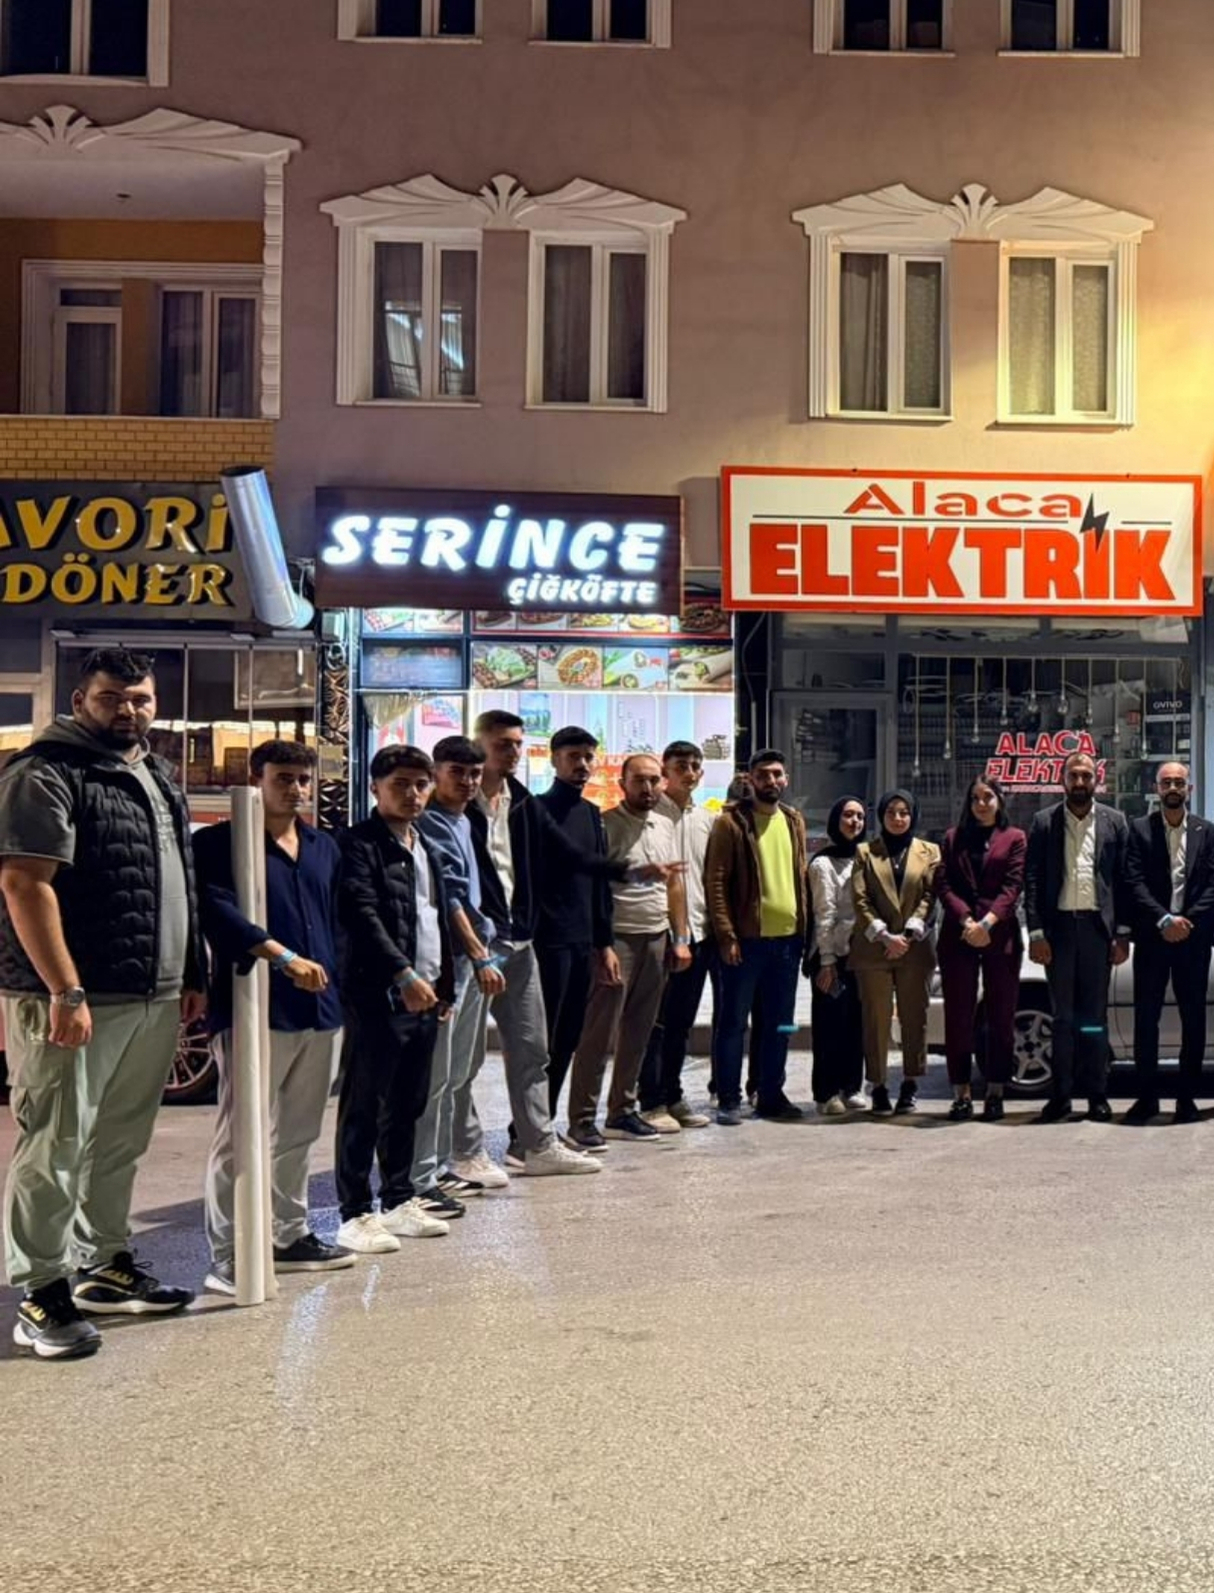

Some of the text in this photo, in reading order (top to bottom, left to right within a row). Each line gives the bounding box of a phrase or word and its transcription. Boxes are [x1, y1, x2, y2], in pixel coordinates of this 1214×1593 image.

[843, 481, 1083, 518] Alaca
[0, 493, 229, 553] VORİ
[321, 503, 666, 572] SERİNCE
[3, 552, 227, 605] DÖNER
[508, 573, 657, 604] ÇİĞKÖFTE
[995, 729, 1096, 756] ALACA
